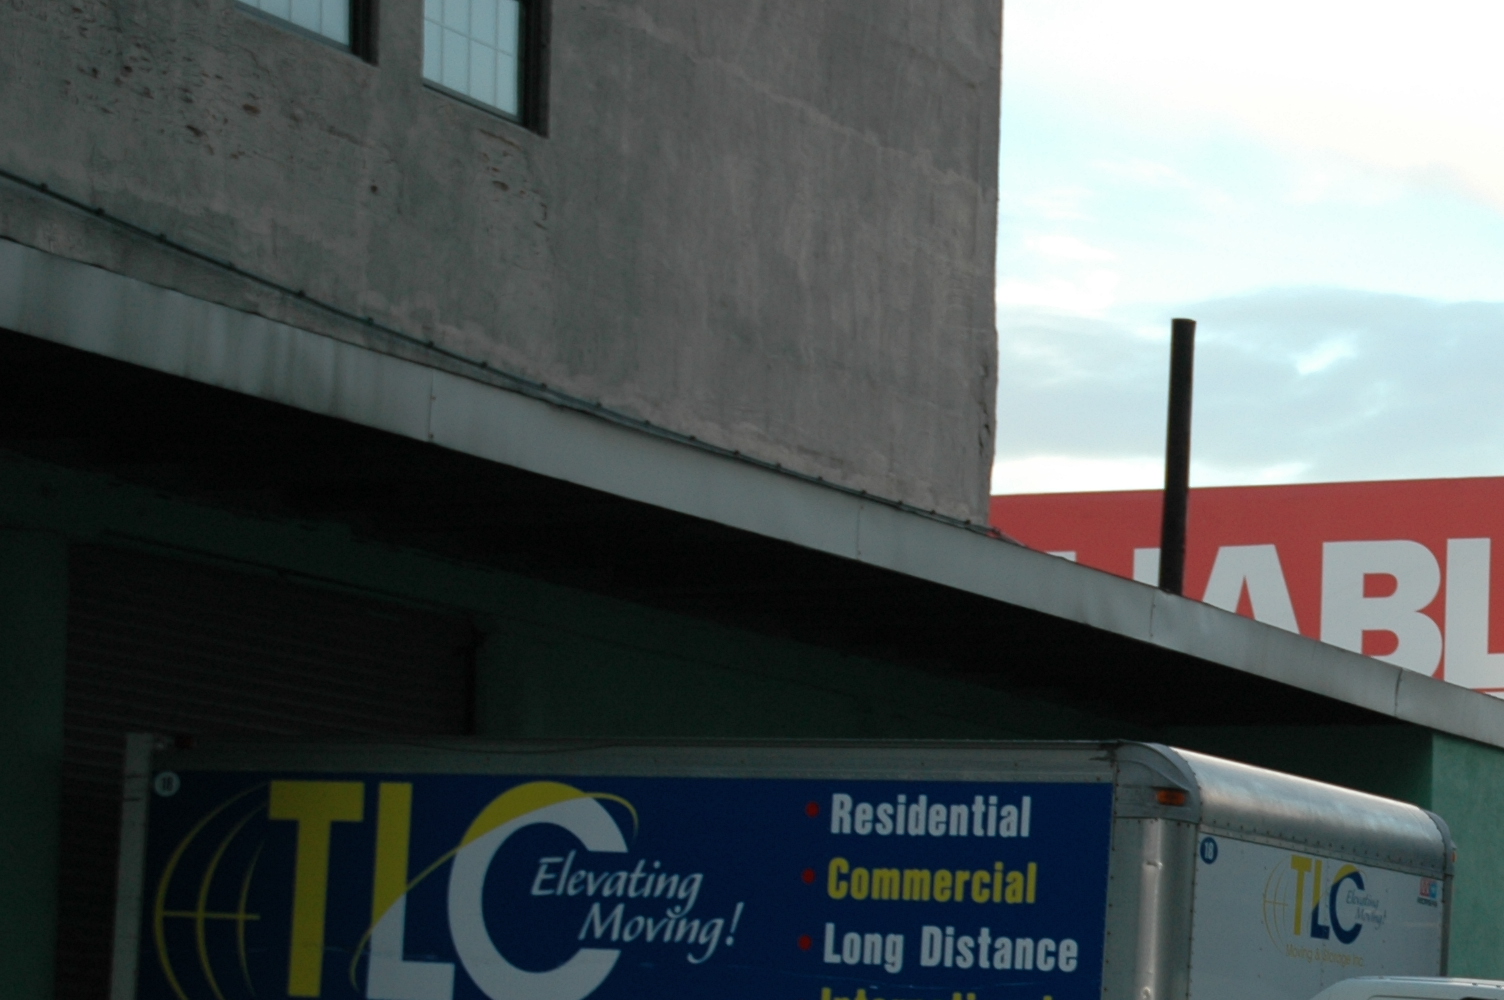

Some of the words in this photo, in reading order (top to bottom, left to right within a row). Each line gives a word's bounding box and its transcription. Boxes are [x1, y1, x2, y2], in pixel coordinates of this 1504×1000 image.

[831, 793, 1031, 837] Residential
[531, 850, 703, 902] Elevating
[1204, 841, 1215, 860] 18
[827, 857, 1037, 904] Commercial
[1290, 854, 1366, 945] TLC
[578, 902, 744, 963] Moving!
[823, 922, 904, 974] Long
[920, 924, 1079, 973] Distance
